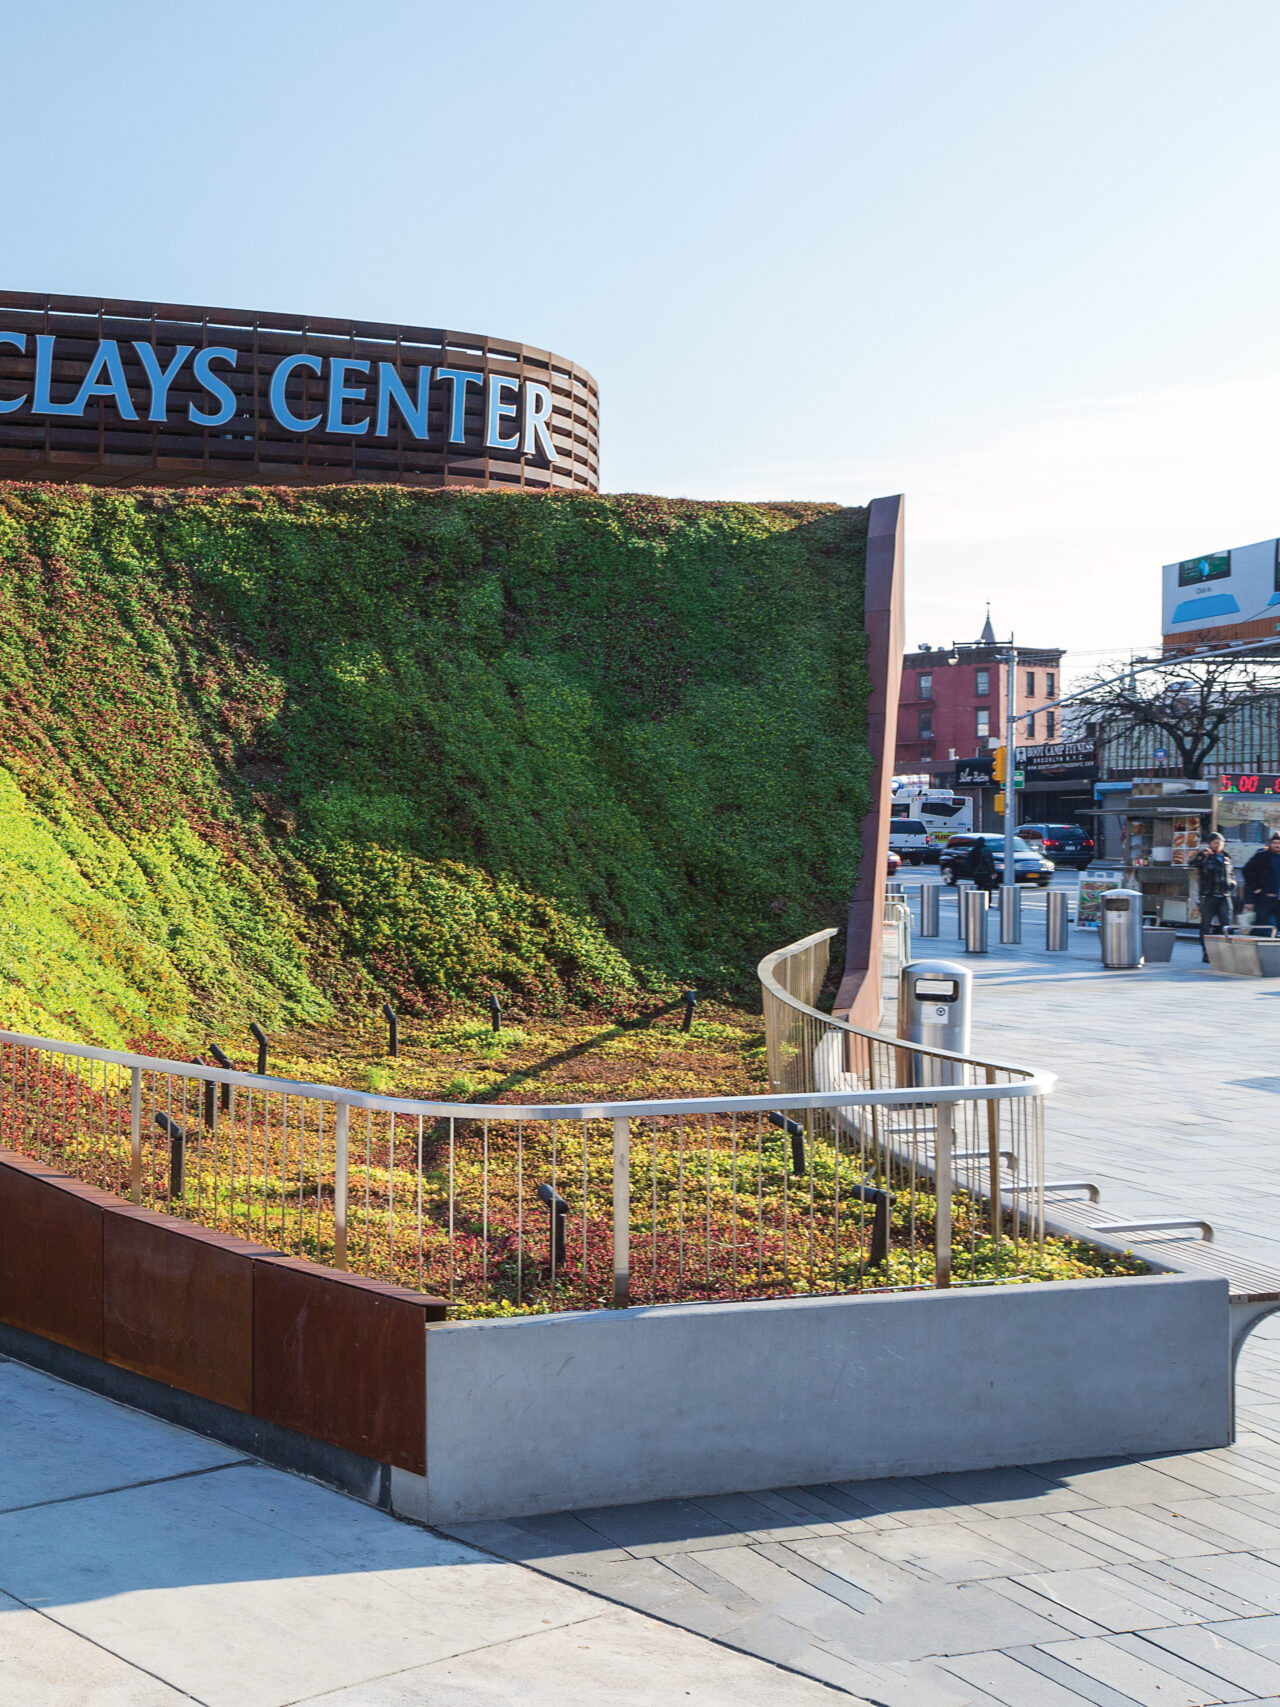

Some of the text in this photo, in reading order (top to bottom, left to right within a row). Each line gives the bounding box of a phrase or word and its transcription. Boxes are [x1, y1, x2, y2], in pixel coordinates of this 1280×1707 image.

[270, 353, 560, 462] CENTER
[1027, 741, 1094, 757] BOOT CAMP FITNESS
